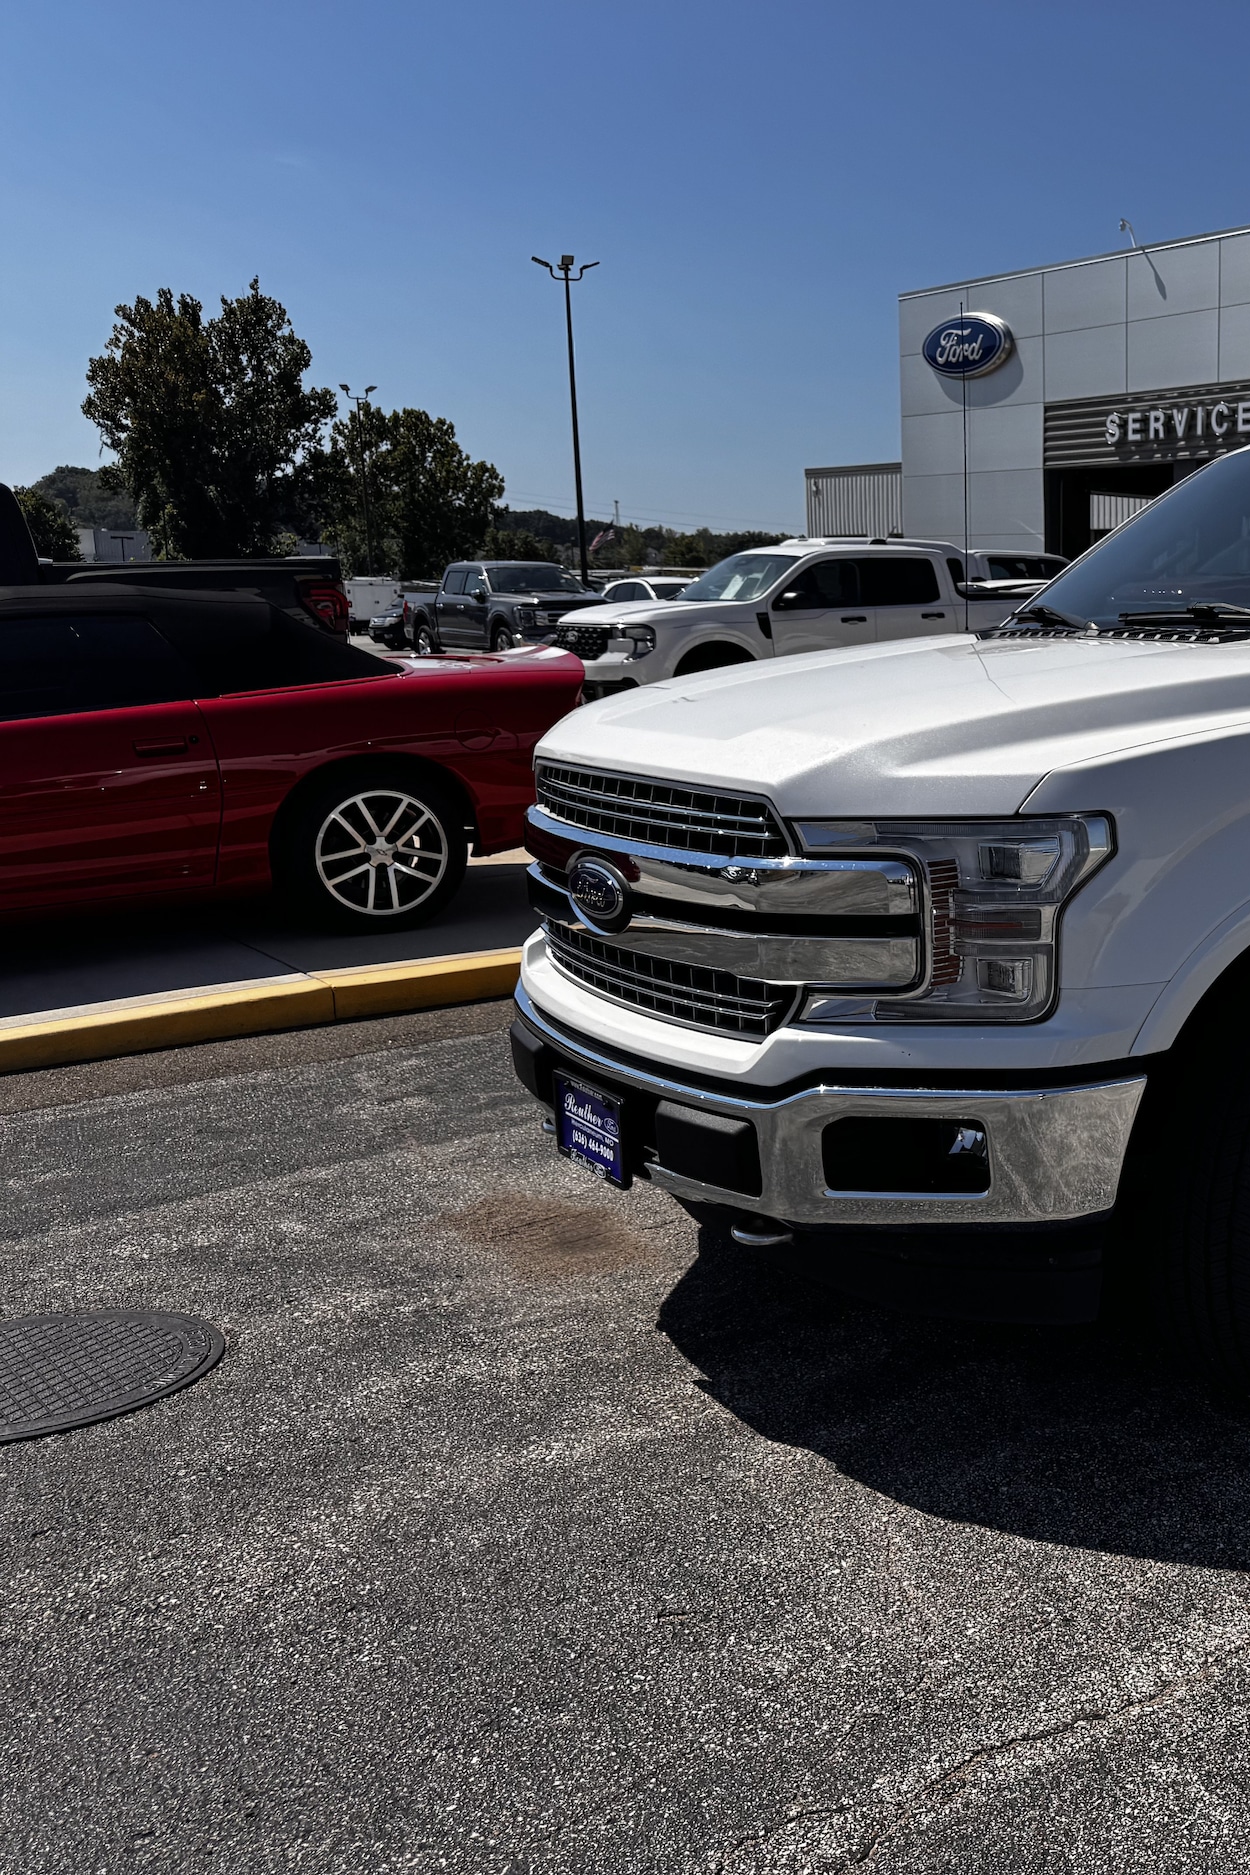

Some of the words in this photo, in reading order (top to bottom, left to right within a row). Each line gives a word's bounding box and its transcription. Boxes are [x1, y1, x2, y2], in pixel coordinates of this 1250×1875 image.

[936, 328, 984, 364] Ford
[577, 874, 605, 907] Ford
[564, 1093, 603, 1127] Reuther
